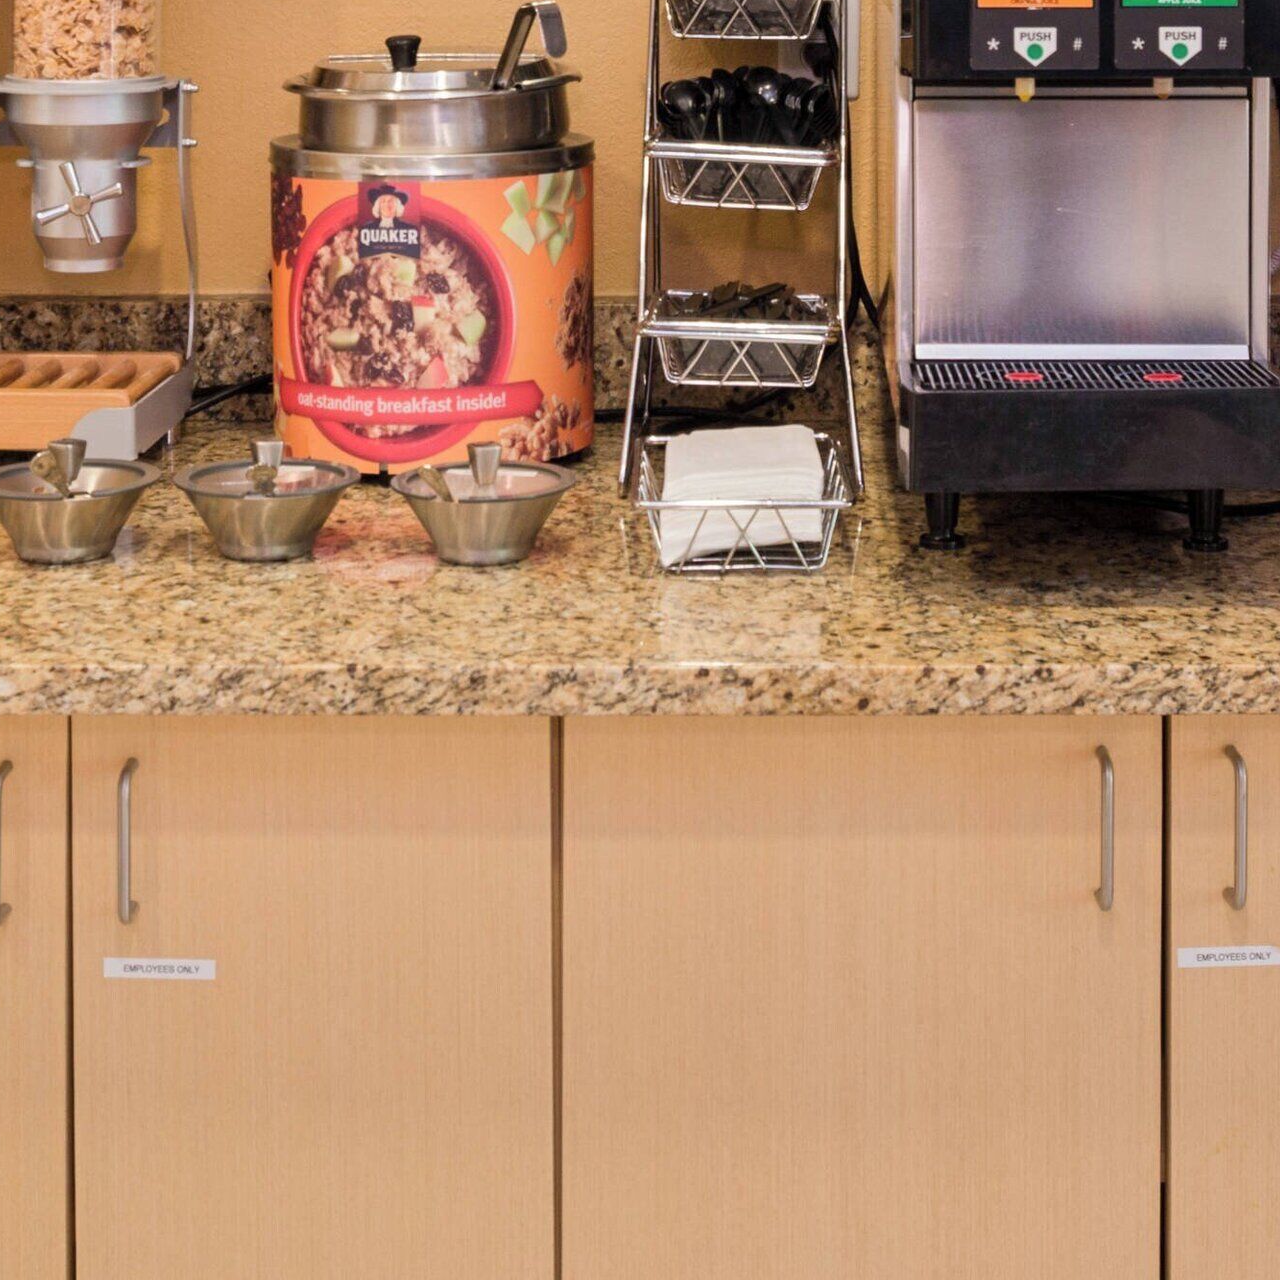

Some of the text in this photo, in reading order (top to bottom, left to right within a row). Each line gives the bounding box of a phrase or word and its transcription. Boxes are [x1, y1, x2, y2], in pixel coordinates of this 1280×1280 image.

[1020, 32, 1051, 41] PUSH
[1164, 31, 1196, 40] PUSH
[361, 229, 418, 246] QUAKER
[298, 392, 507, 416] oat-standing breakfast inside!
[1196, 952, 1272, 962] EMPLOYEES ONLY
[123, 964, 200, 974] EMPLOYEES ONLY
